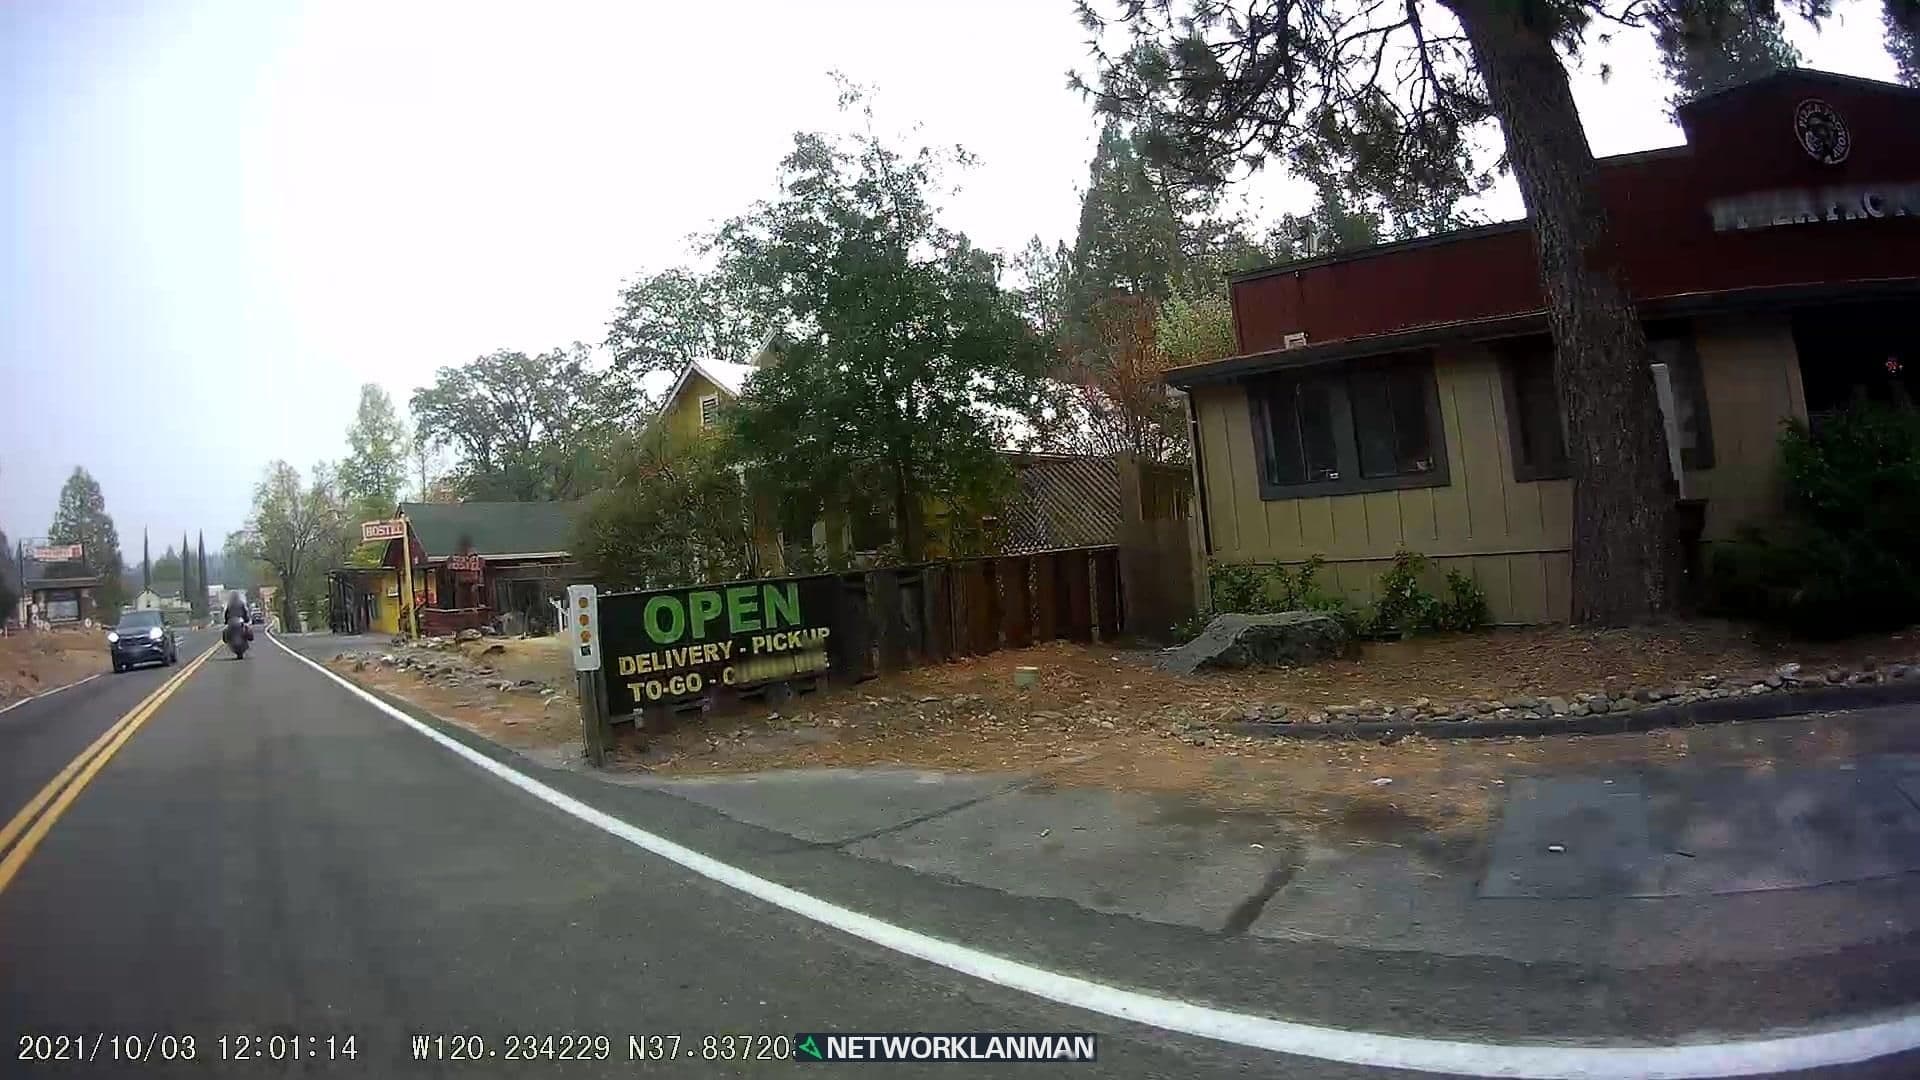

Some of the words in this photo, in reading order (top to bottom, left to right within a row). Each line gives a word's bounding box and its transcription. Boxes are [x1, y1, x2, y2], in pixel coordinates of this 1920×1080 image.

[643, 582, 802, 645] OPEN
[618, 639, 734, 677] DELIVERY
[751, 627, 831, 655] PICKUP
[627, 672, 703, 703] TO-GO
